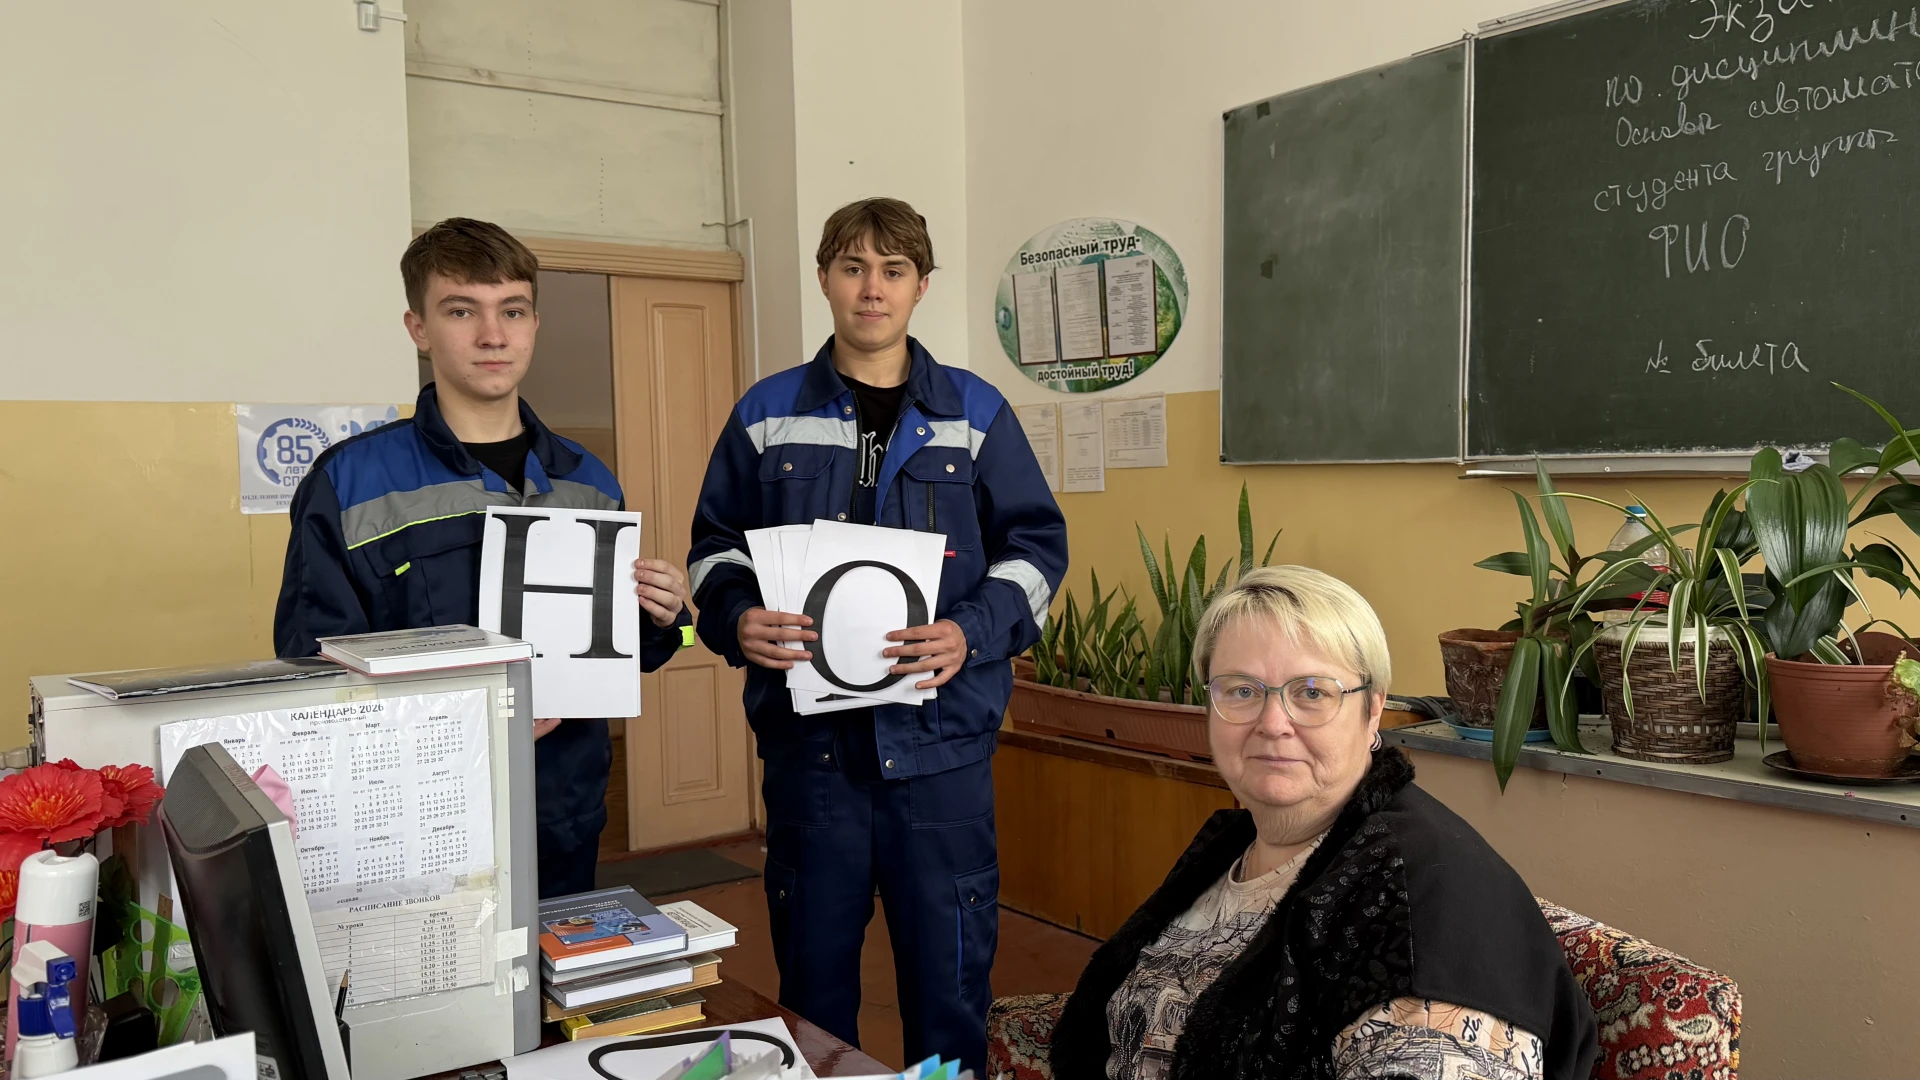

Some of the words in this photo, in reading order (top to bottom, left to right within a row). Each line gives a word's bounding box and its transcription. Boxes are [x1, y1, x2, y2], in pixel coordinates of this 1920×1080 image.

[1689, 0, 1833, 43] Экз
[1748, 61, 1920, 119] автомат
[1594, 161, 1738, 213] студента
[1020, 239, 1099, 266] Безопасный
[1102, 235, 1141, 254] труд-
[1649, 214, 1750, 278] ФИО
[1037, 366, 1099, 382] достойный
[1101, 361, 1133, 379] труд!
[1691, 339, 1810, 375] билета
[277, 435, 314, 464] 85
[283, 476, 302, 487] СП
[284, 465, 307, 474] лет
[492, 513, 637, 658] Н
[290, 707, 357, 721] КАЛЕНДАРЬ
[359, 703, 384, 714] 2026
[432, 825, 455, 833] Декабрь
[349, 899, 403, 913] РАСПИСАНИЕ
[404, 894, 441, 906] ЗВОНКОВ
